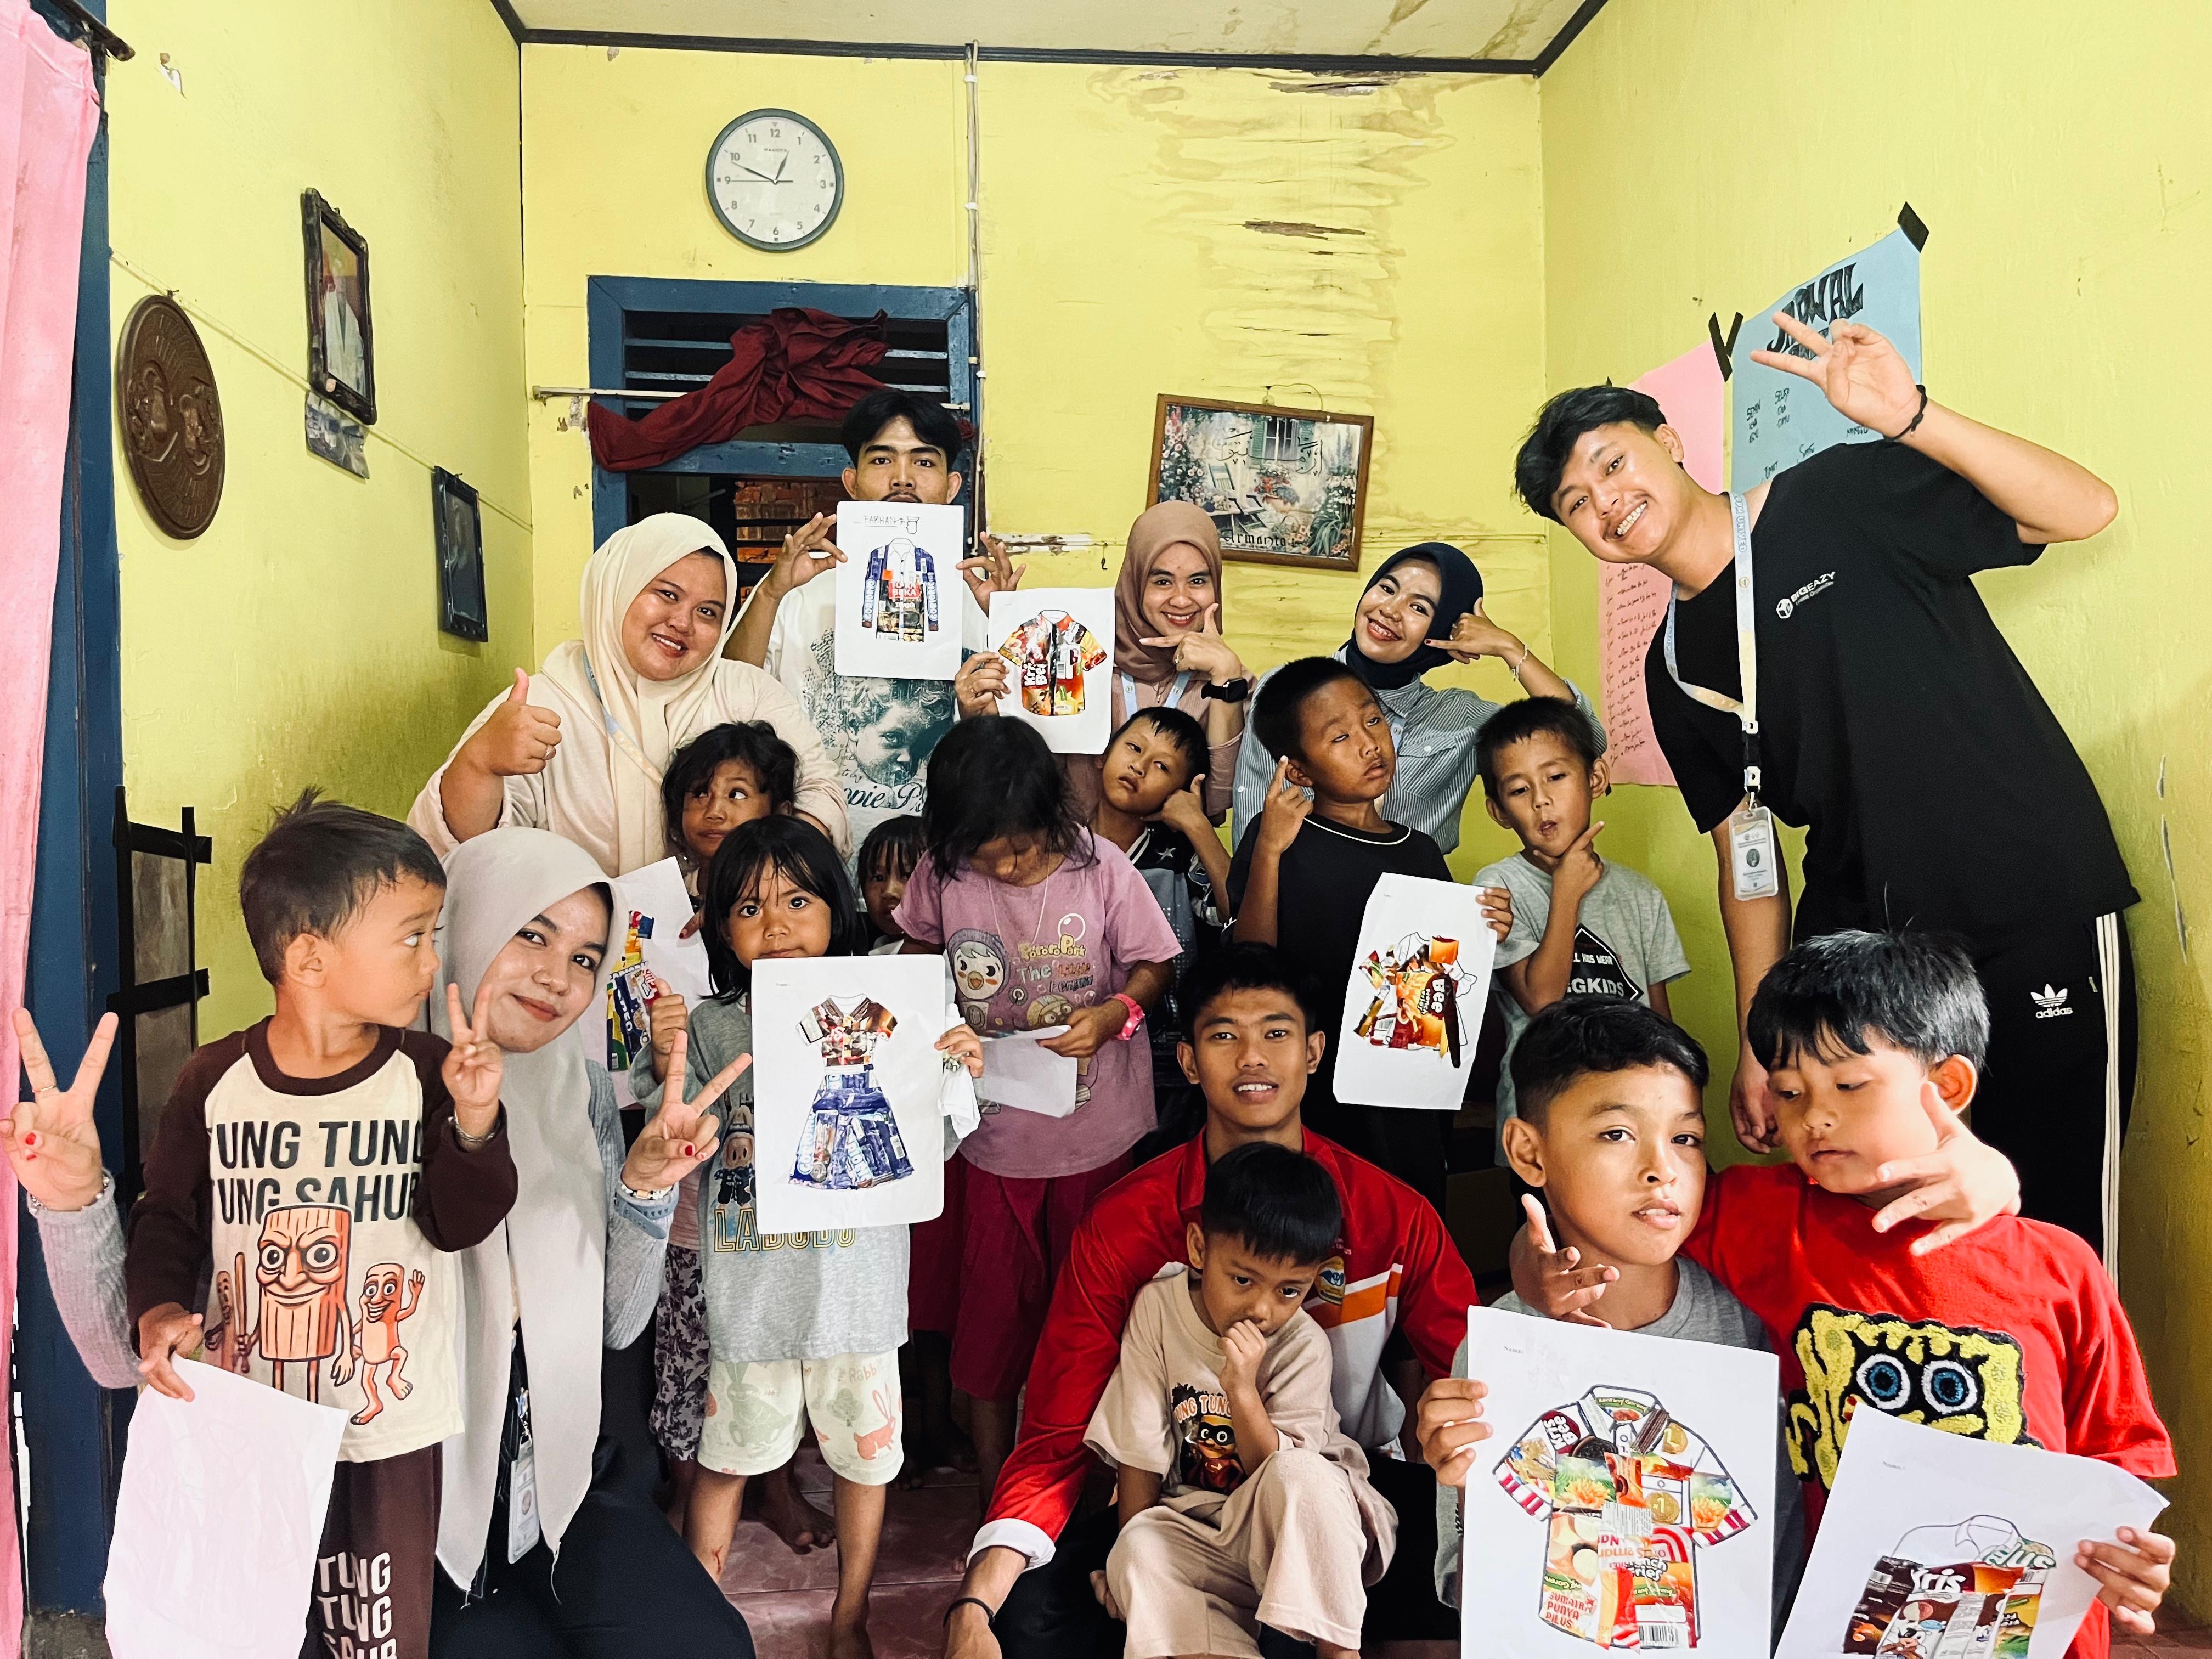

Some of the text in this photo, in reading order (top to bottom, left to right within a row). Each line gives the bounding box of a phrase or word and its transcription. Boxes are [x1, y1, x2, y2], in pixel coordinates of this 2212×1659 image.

[770, 128, 781, 138] 12
[748, 134, 757, 143] 11
[797, 137, 802, 145] 1
[730, 152, 740, 161] 10
[814, 155, 820, 164] 2
[725, 176, 731, 184] 9
[820, 180, 826, 189] 3
[731, 201, 738, 209] 8
[814, 204, 820, 213] 4
[772, 227, 779, 235] 6
[1018, 964, 1052, 984] The
[1567, 977, 1624, 997] GKIDS
[2035, 1007, 2073, 1019] adidas
[318, 1552, 391, 1598] TUNG
[316, 1594, 392, 1642] TUNG
